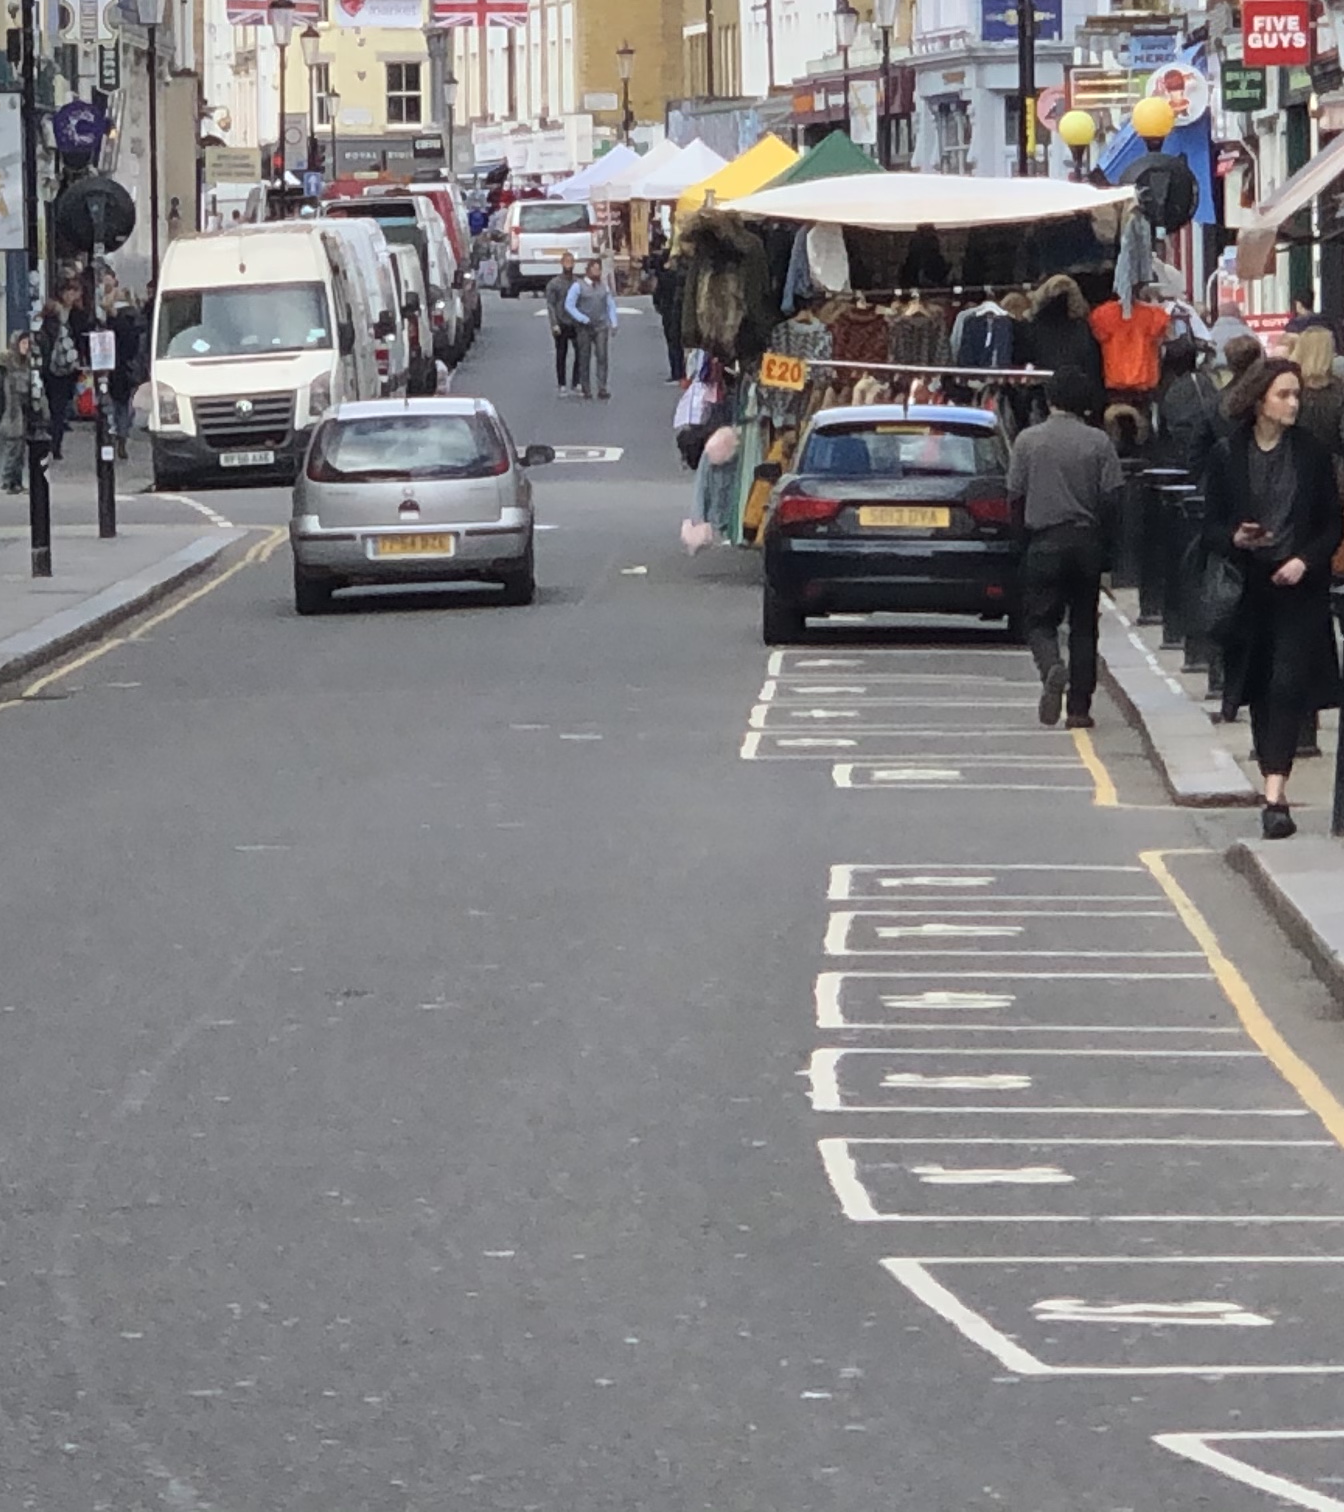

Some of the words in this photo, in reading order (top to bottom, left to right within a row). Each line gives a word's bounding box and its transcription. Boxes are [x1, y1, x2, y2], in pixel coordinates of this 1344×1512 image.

[1253, 15, 1300, 32] FIVE
[1247, 32, 1307, 49] GUYS
[765, 358, 802, 383] £20
